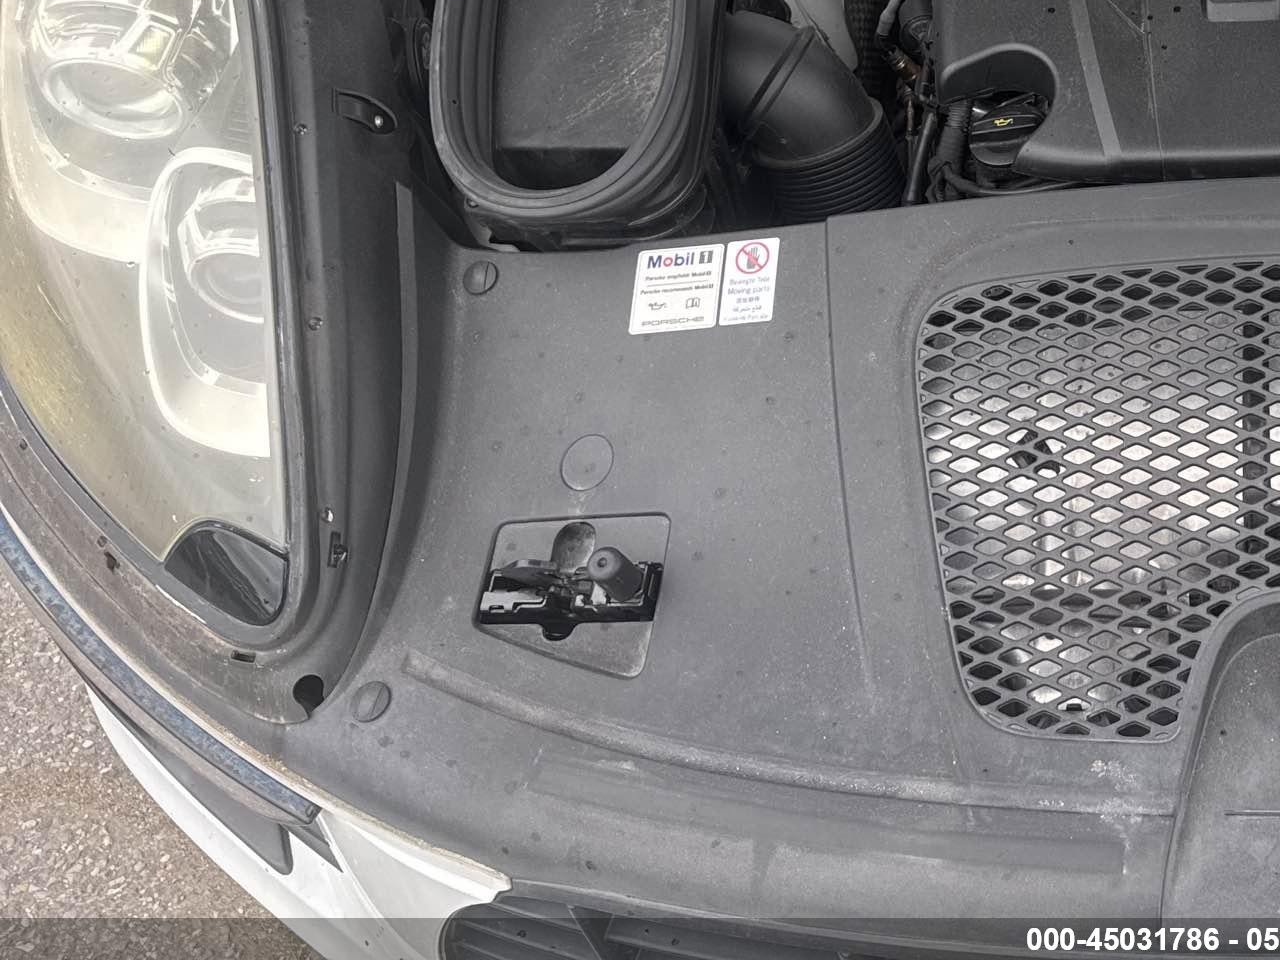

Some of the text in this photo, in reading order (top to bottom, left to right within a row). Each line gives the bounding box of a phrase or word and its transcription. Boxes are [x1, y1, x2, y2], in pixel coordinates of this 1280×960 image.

[647, 250, 713, 269] Mobil 1
[727, 285, 770, 295] Moving parts
[641, 316, 705, 327] PORSCHE
